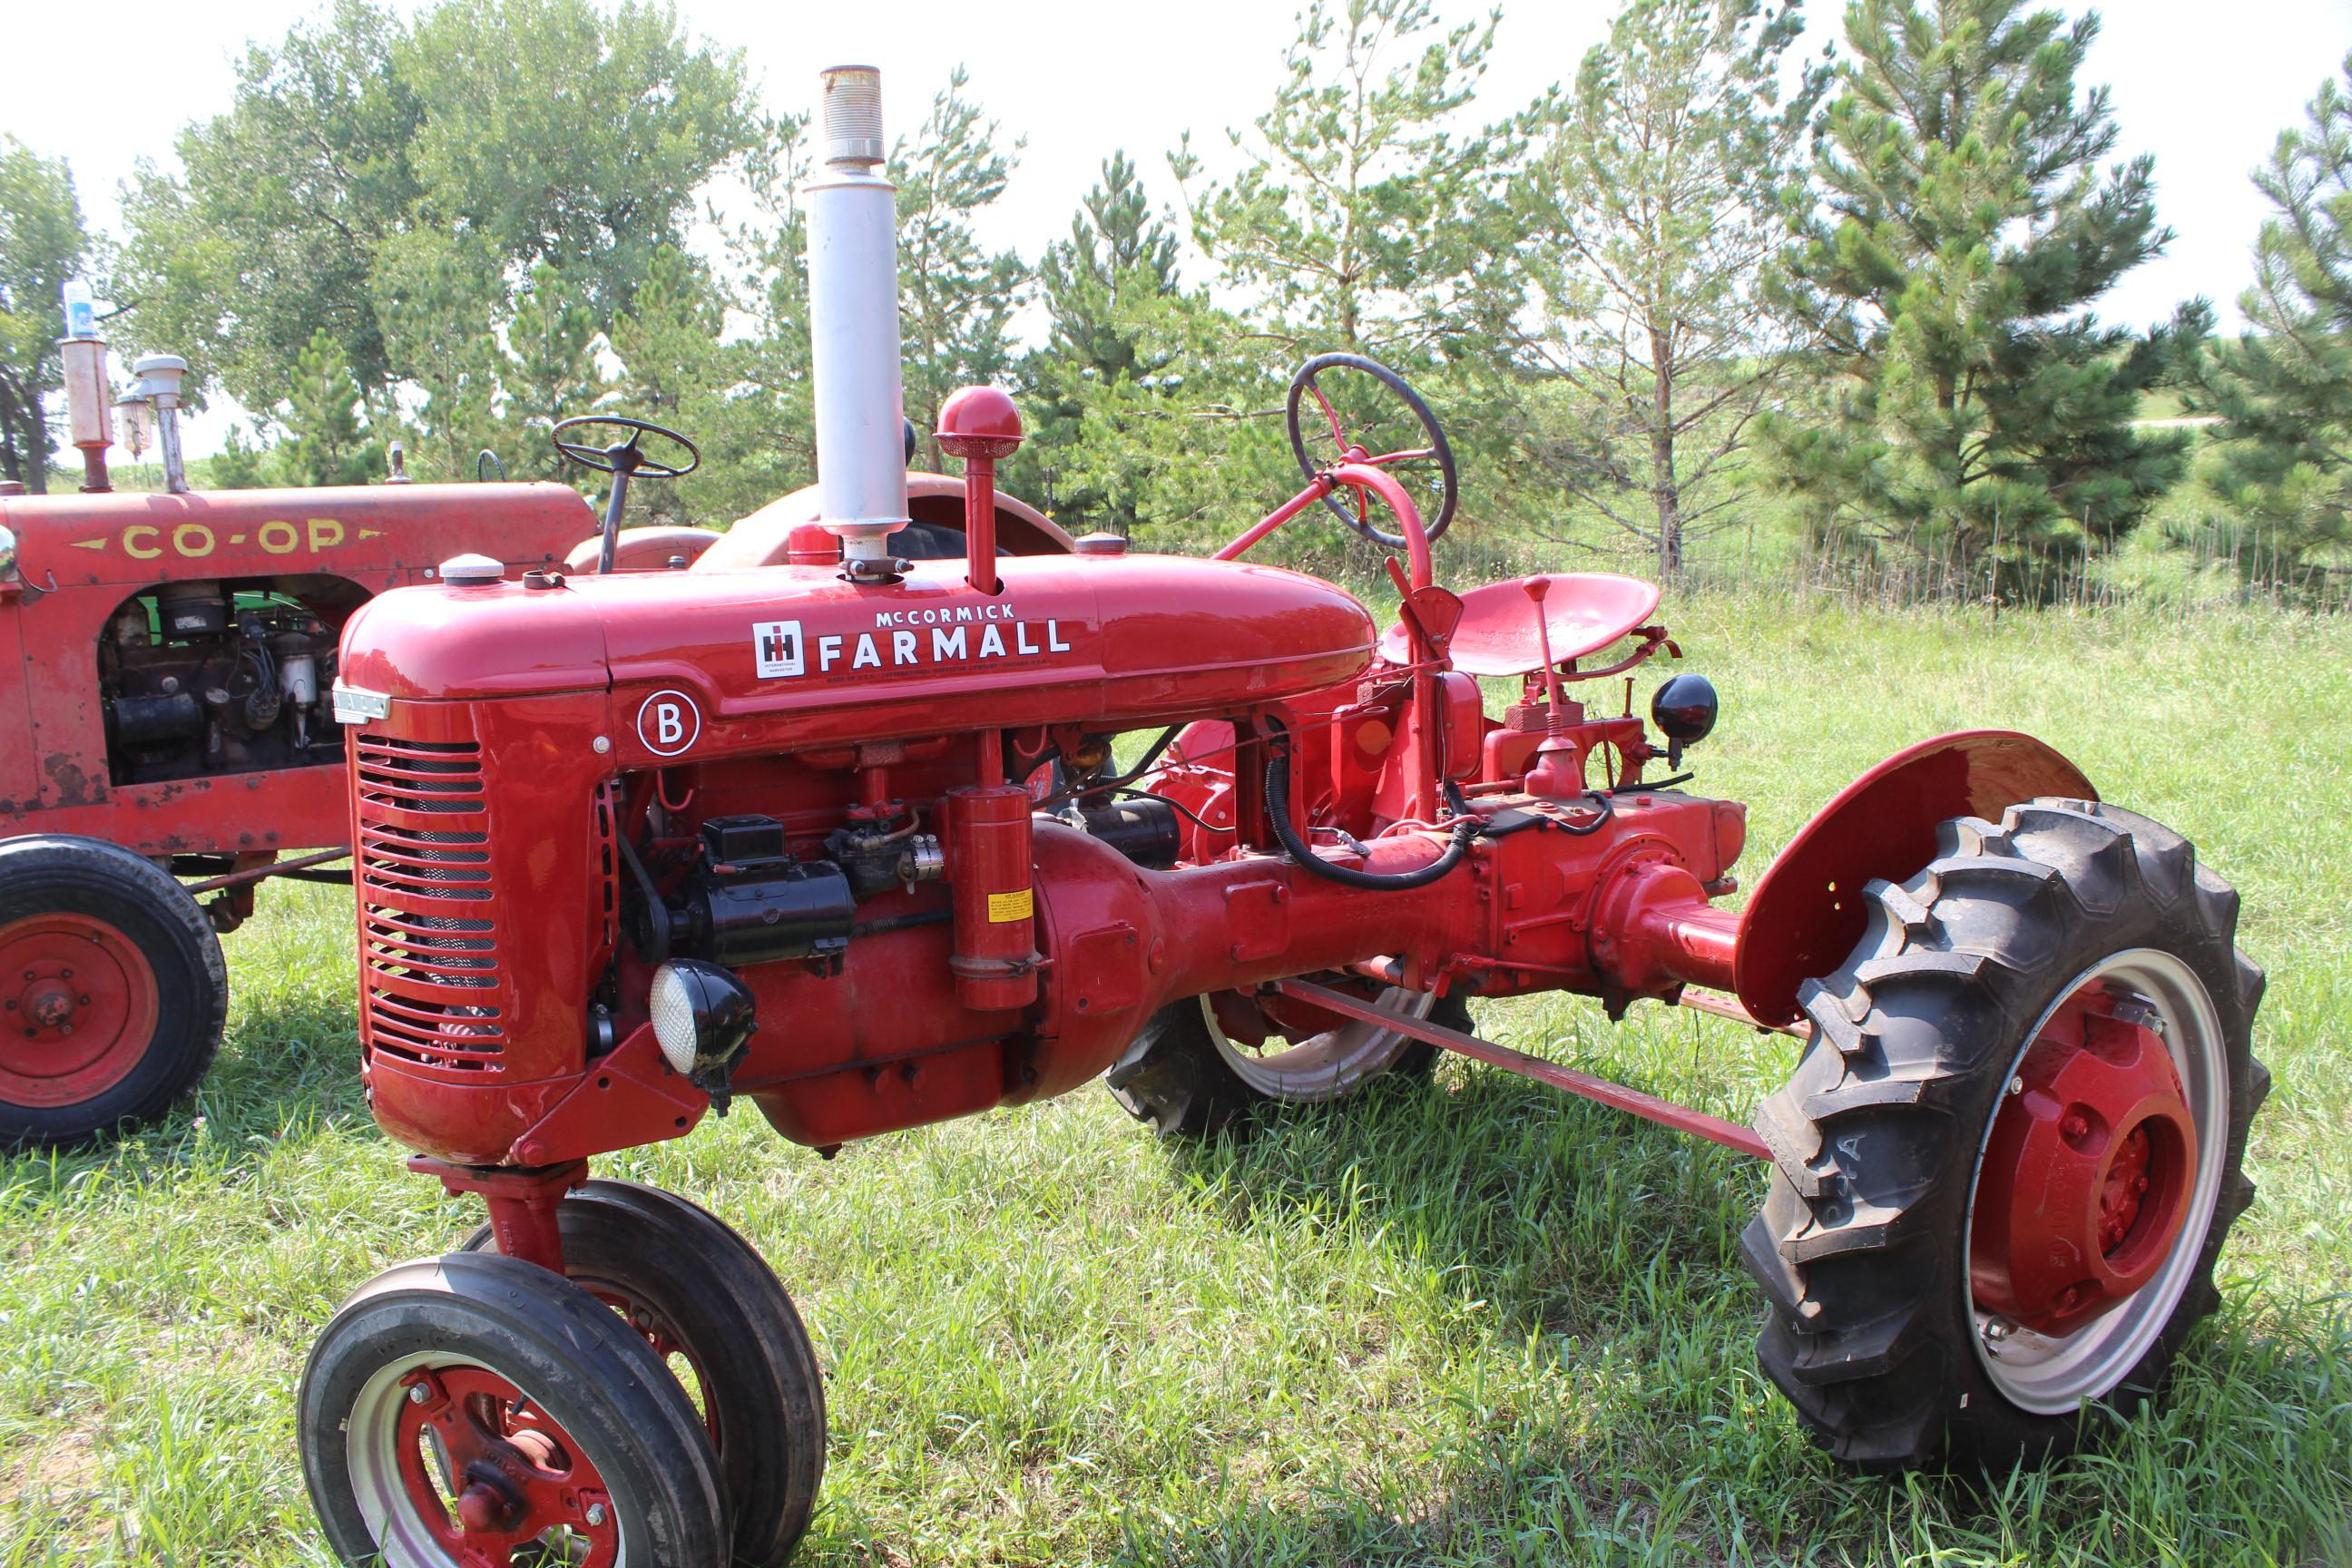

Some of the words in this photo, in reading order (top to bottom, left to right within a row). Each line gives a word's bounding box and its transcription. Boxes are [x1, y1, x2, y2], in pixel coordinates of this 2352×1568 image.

[122, 518, 344, 559] CO-OP
[818, 619, 1071, 671] FARMALL
[657, 703, 683, 744] B
